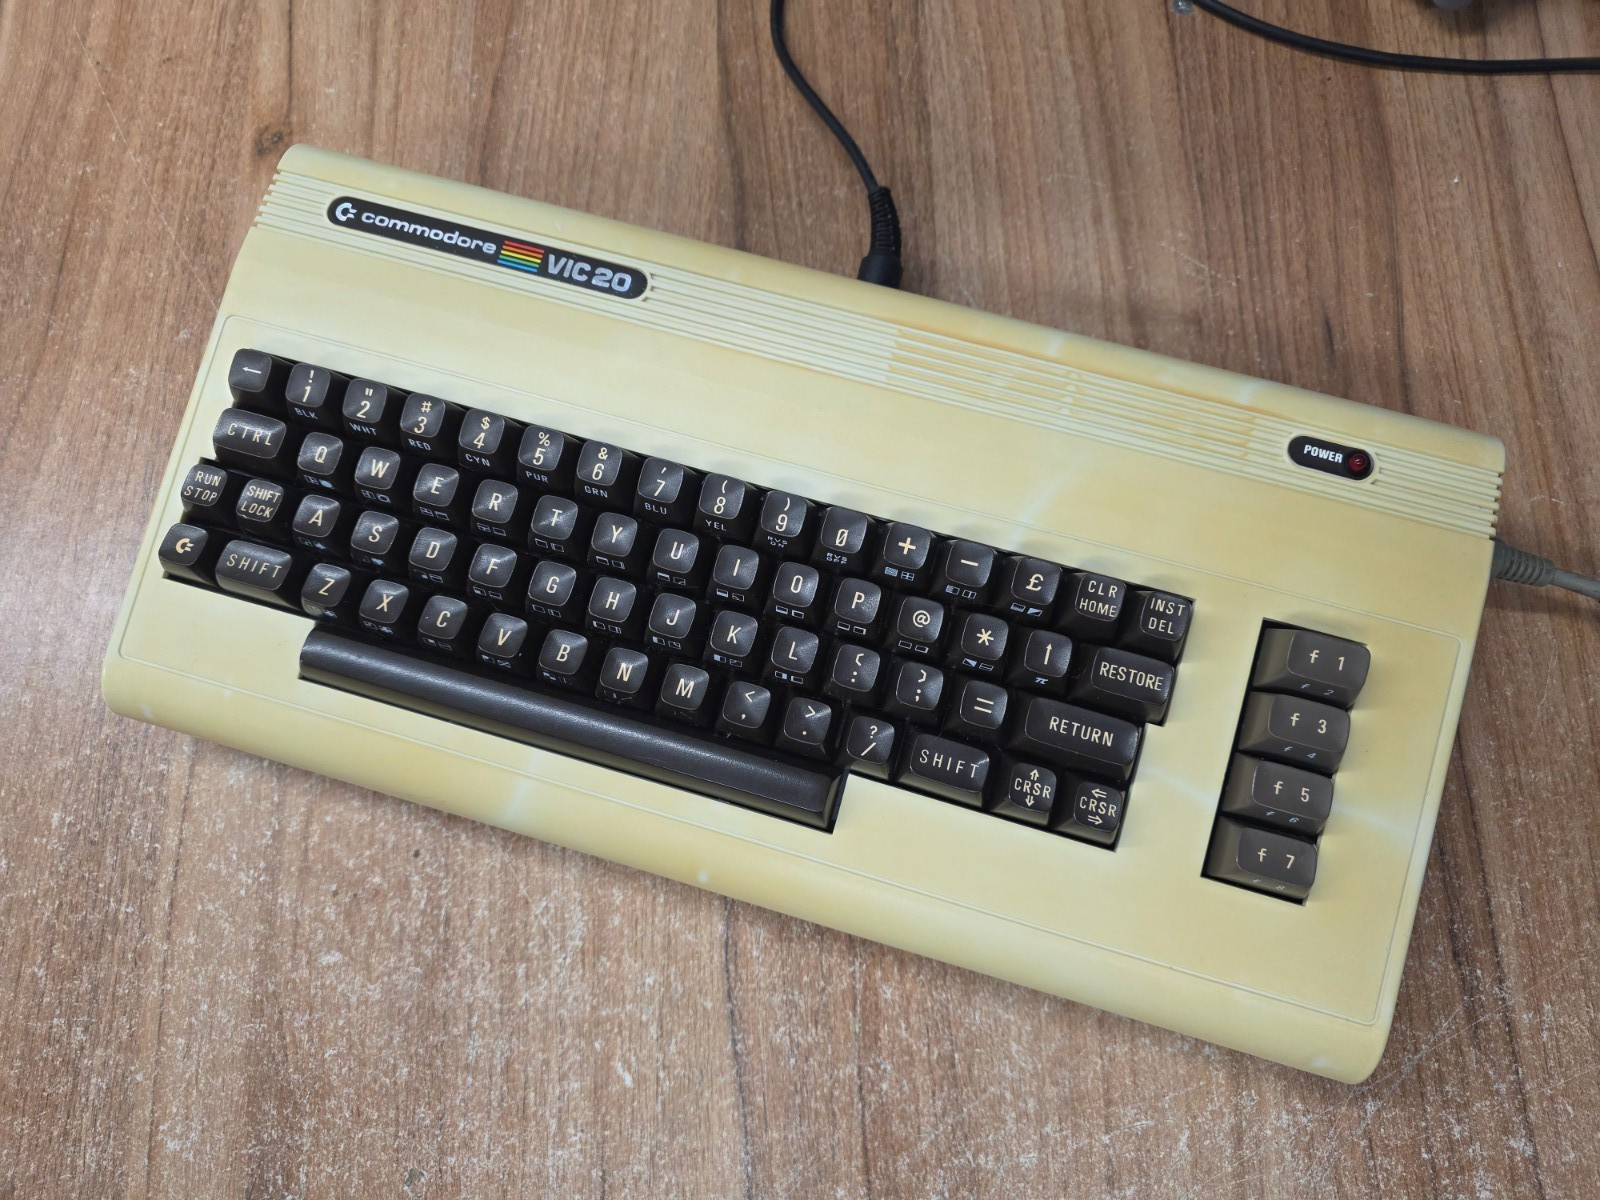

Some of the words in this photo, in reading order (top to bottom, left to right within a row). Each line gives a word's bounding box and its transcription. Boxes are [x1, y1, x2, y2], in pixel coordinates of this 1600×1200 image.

[361, 211, 497, 255] commodore
[547, 254, 592, 283] VIC
[591, 270, 632, 293] 20
[309, 370, 315, 383] !
[303, 386, 312, 402] 1
[295, 408, 318, 420] BLK
[356, 401, 371, 419] 2
[421, 401, 432, 413] #
[350, 423, 377, 436] WHT
[414, 416, 427, 434] 3
[481, 417, 490, 431] $
[227, 422, 272, 446] CTRL
[474, 432, 485, 449] 4
[538, 432, 550, 446] %
[408, 438, 431, 450] RED
[315, 446, 328, 464] Q
[465, 453, 491, 467] CYN
[533, 448, 546, 466] 5
[598, 447, 608, 460] &
[1304, 444, 1343, 463] POWER
[371, 459, 390, 479] W
[525, 471, 549, 483] PUR
[592, 463, 605, 481] 6
[195, 471, 221, 487] RUN
[431, 476, 444, 495] E
[184, 486, 218, 502] STOP
[247, 486, 281, 503] SHIFT
[584, 485, 609, 498] GRN
[654, 480, 666, 497] 7
[240, 501, 273, 518] LOCK
[489, 492, 502, 511] R
[644, 503, 668, 515] BLU
[713, 497, 727, 514] 8
[309, 509, 324, 527] A
[550, 508, 563, 526] T
[705, 519, 727, 532] YEL
[775, 514, 788, 532] 9
[368, 525, 383, 543] S
[611, 524, 623, 544] Y
[426, 541, 440, 560] D
[671, 542, 684, 560] U
[227, 553, 283, 578] SHIFT
[486, 557, 500, 575] F
[733, 559, 741, 576] I
[318, 578, 335, 596] Z
[546, 576, 560, 594] G
[1026, 573, 1044, 591] £
[1088, 580, 1118, 598] CLR
[375, 594, 394, 612] X
[606, 591, 621, 610] H
[851, 591, 865, 609] P
[1150, 598, 1187, 617] INST
[666, 609, 681, 626] J
[912, 610, 931, 627] @
[1079, 601, 1117, 618] HOME
[436, 610, 451, 628] C
[1148, 617, 1175, 635] DEL
[497, 628, 511, 646] V
[726, 625, 742, 644] K
[556, 644, 571, 662] B
[789, 641, 797, 660] L
[1309, 650, 1320, 664] f
[1338, 656, 1345, 671] 1
[616, 662, 632, 682] N
[1099, 662, 1164, 691] RESTORE
[675, 678, 695, 698] M
[870, 725, 878, 739] ?
[1049, 716, 1114, 747] RETURN
[1290, 713, 1300, 726] f
[1318, 719, 1327, 733] 3
[919, 749, 980, 778] SHIFT
[1014, 778, 1051, 799] CRSR
[1273, 781, 1283, 795] f
[1300, 787, 1310, 802] 5
[1079, 796, 1117, 817] CRSR
[1258, 848, 1267, 862] f
[1286, 855, 1295, 869] 7
